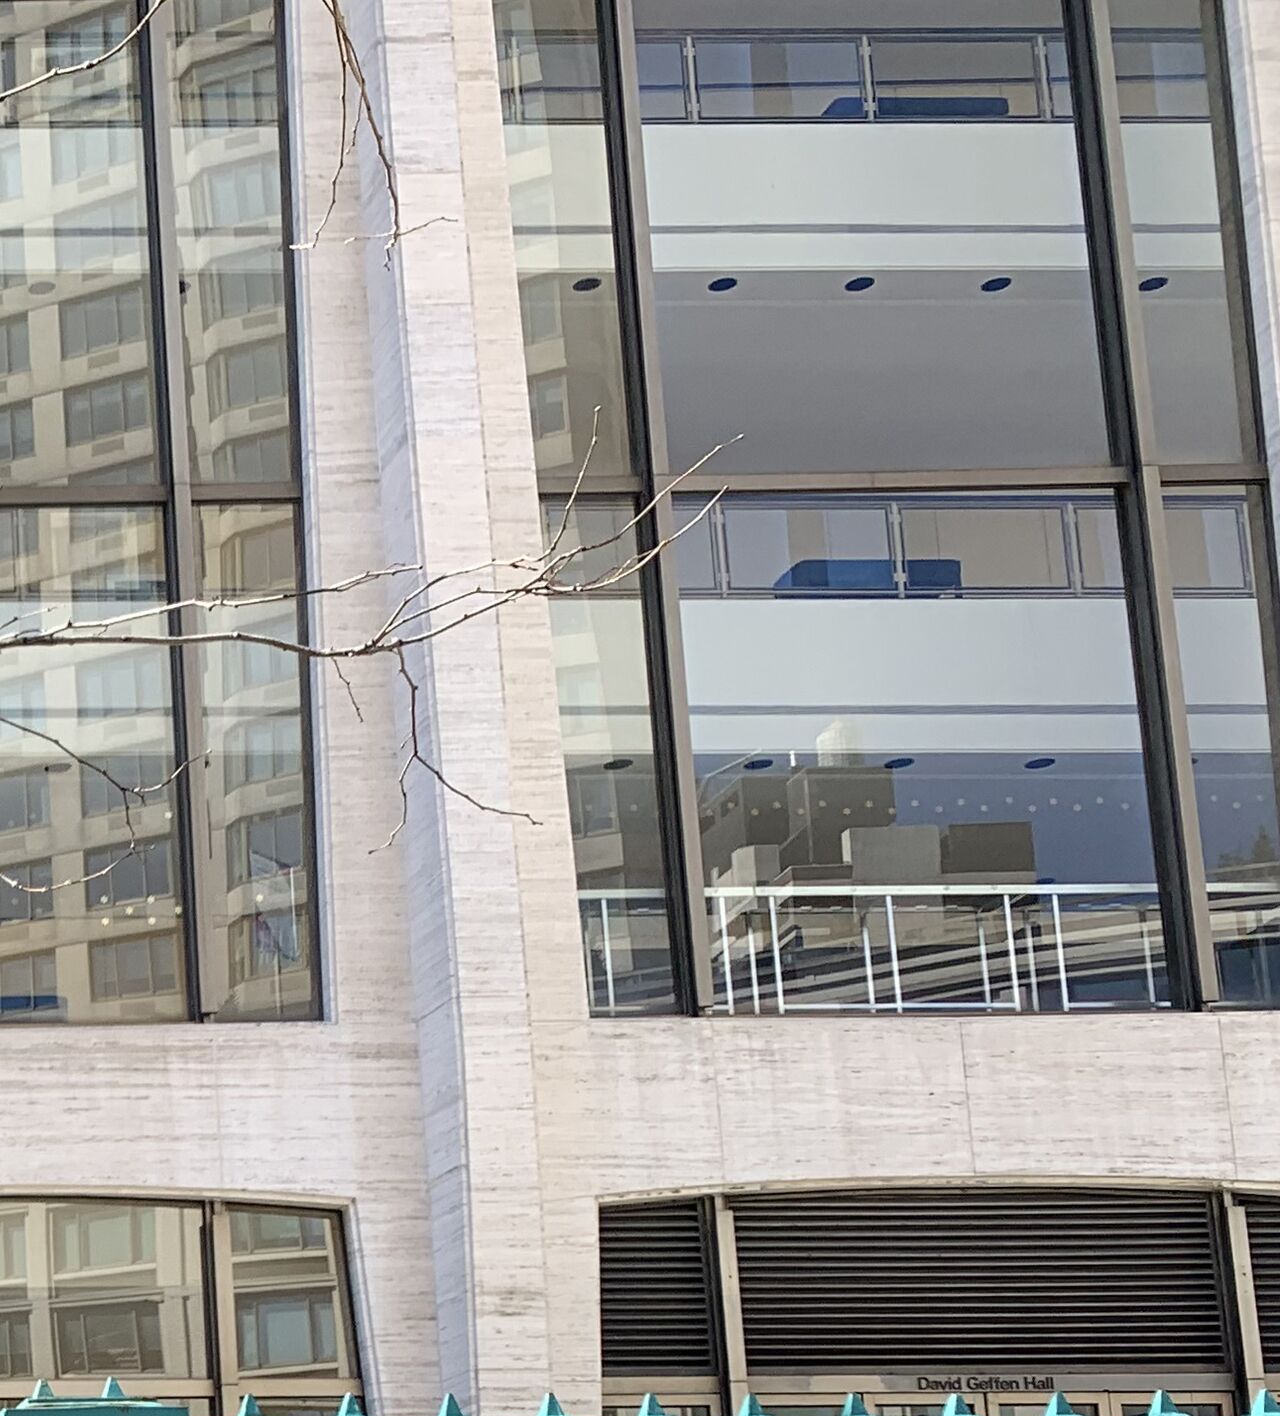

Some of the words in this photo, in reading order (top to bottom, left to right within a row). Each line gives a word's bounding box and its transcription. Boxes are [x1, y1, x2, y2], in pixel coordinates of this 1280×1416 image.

[916, 1376, 962, 1391] David
[966, 1376, 1020, 1391] Geffen
[1023, 1375, 1055, 1390] Hall
